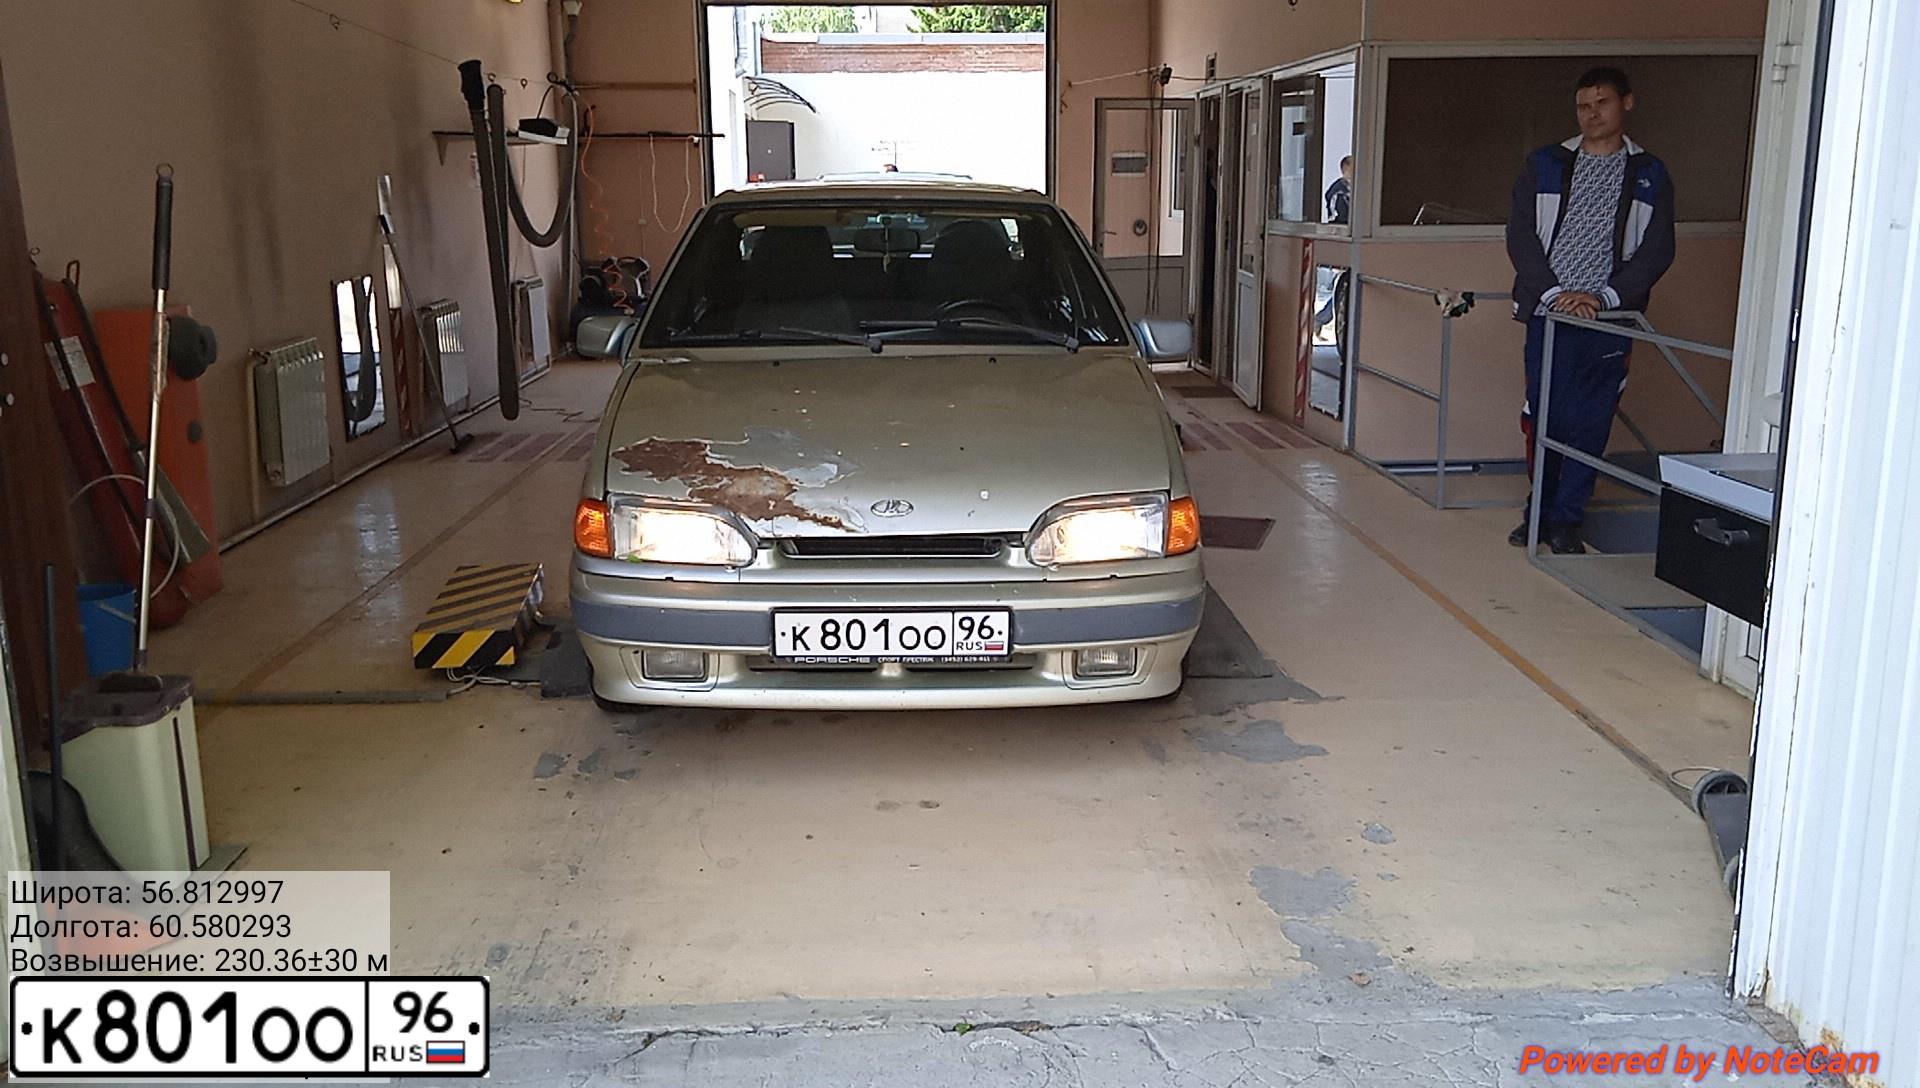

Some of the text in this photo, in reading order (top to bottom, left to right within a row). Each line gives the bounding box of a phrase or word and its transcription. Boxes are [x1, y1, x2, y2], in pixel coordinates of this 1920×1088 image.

[958, 615, 995, 641] 96
[956, 641, 983, 651] RUS
[794, 656, 871, 664] PORSCHE
